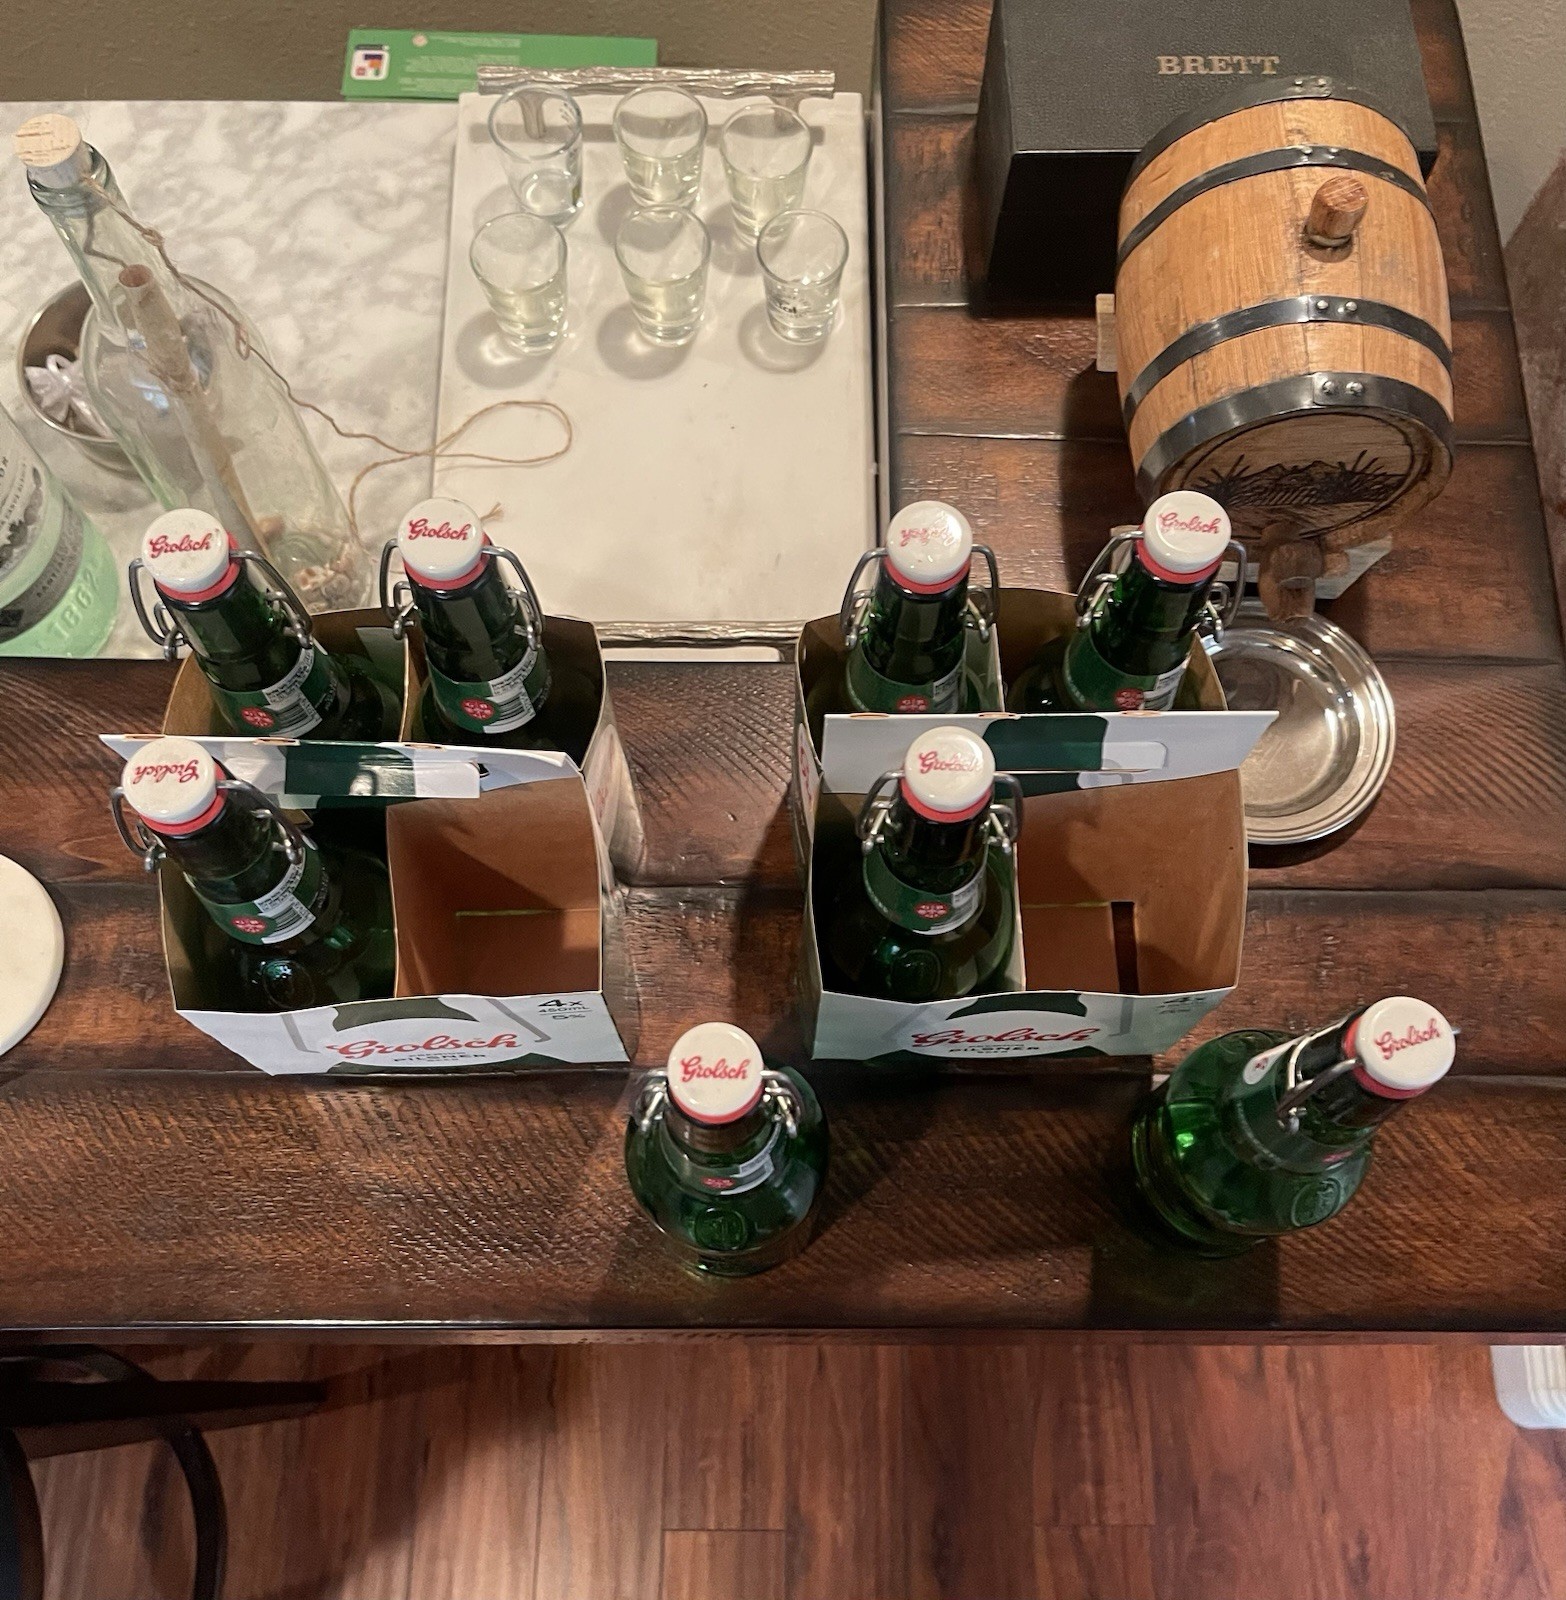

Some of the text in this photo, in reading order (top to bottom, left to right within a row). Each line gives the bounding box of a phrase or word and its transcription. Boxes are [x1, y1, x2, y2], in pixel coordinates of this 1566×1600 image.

[1157, 55, 1280, 75] BRETT
[408, 518, 471, 540] Grolsch
[1158, 512, 1221, 534] Grolsch
[149, 534, 213, 559] Grolsch
[132, 759, 199, 784] Grolsch
[538, 999, 583, 1008] 4x
[326, 1033, 521, 1060] Grolsch
[911, 1028, 1100, 1048] Grolsch
[1374, 1018, 1441, 1060] Grolsch
[680, 1056, 751, 1083] Grolsch
